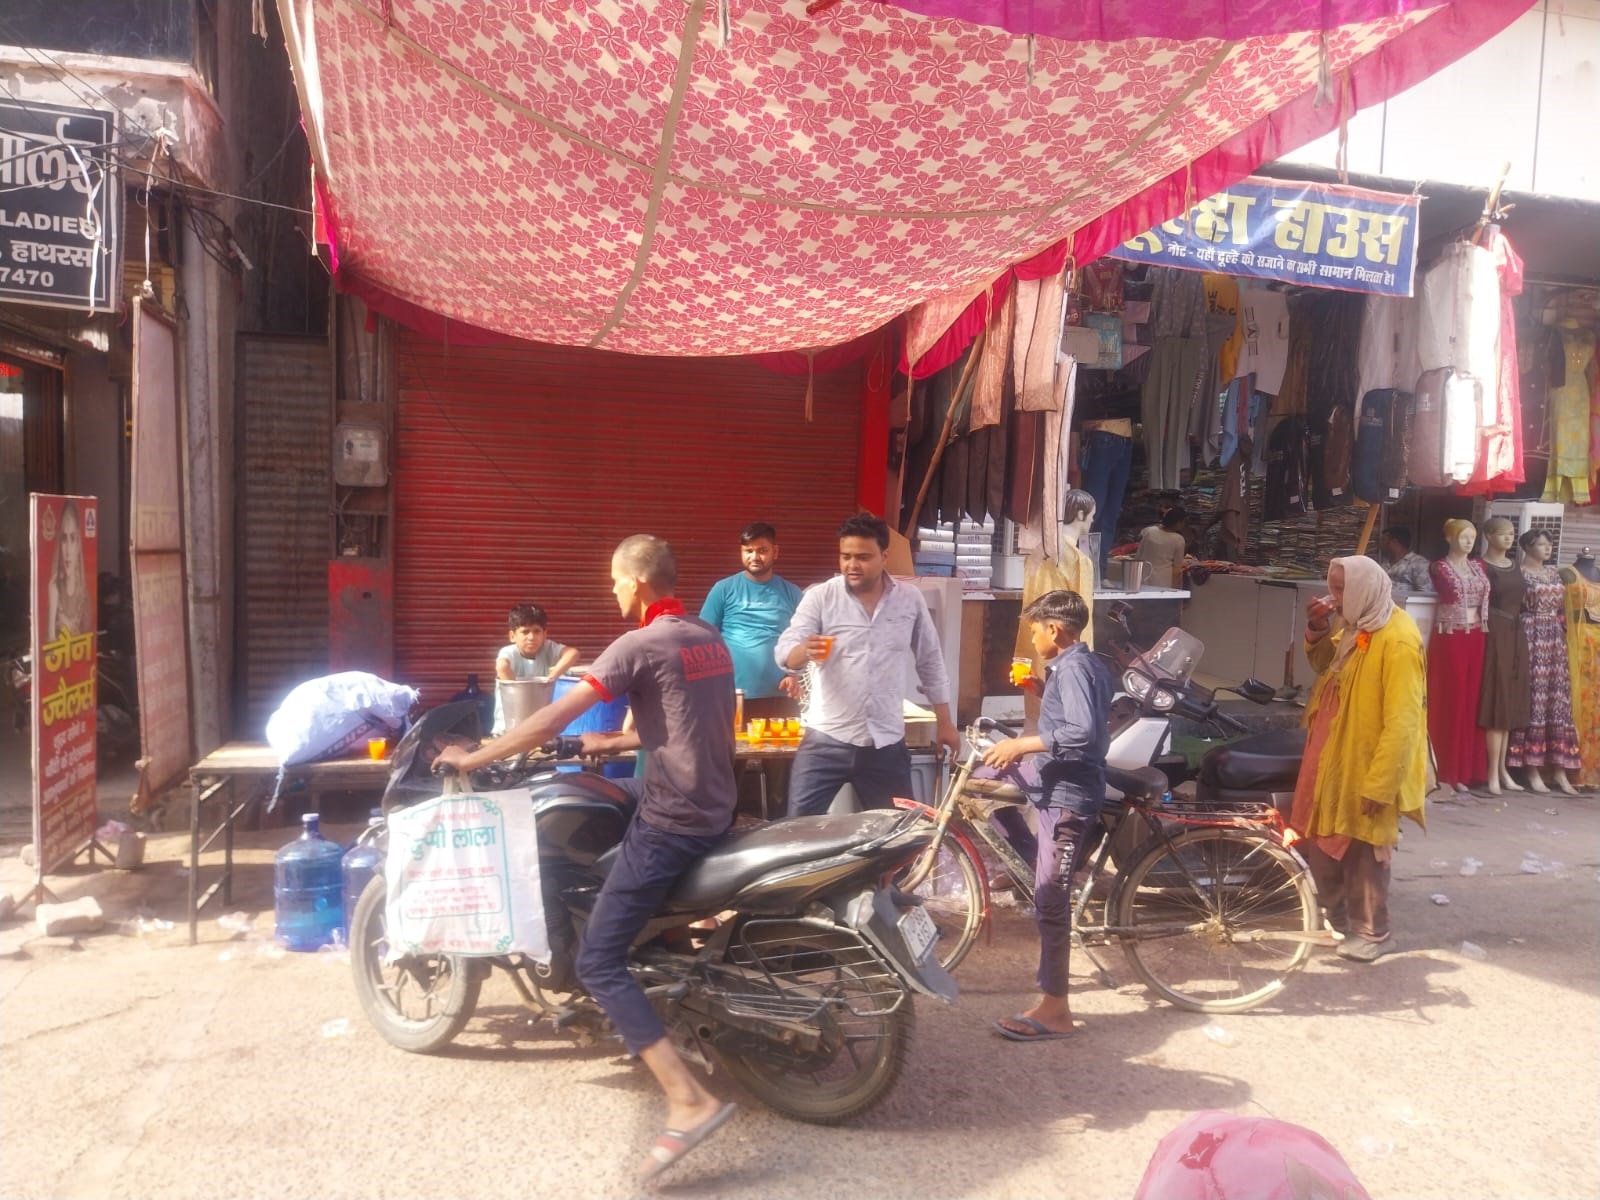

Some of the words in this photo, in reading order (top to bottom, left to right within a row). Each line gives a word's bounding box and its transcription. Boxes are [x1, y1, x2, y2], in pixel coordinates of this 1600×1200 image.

[1271, 199, 1409, 266] हाउस
[11, 240, 94, 267] हाथरस
[0, 267, 55, 287] 7470
[1257, 255, 1285, 271] सजाने
[1319, 264, 1354, 280] सामान
[1354, 266, 1383, 284] मिलता
[42, 624, 94, 673] जैन
[452, 826, 497, 848] लाला
